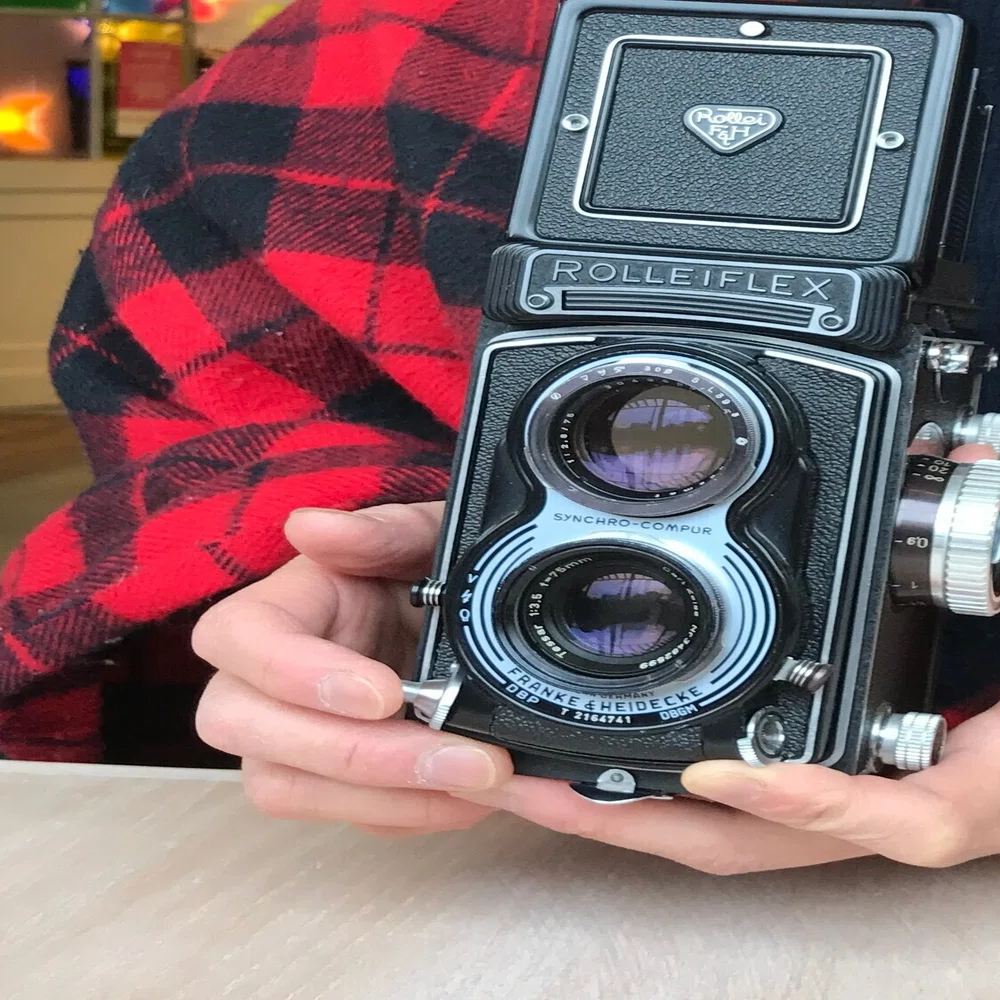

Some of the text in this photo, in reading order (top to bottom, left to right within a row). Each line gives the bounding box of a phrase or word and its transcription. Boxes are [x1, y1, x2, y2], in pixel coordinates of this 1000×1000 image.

[697, 107, 768, 126] Rollei
[552, 259, 832, 301] ROLLEIFLEX
[553, 512, 713, 536] SYNCHRO-COMPUR
[533, 624, 567, 659] Tessar
[505, 684, 540, 705] DBP
[507, 667, 581, 706] FRANKE
[600, 686, 703, 712] HEIDECKE
[560, 707, 569, 716] T
[659, 704, 699, 721] DBGM
